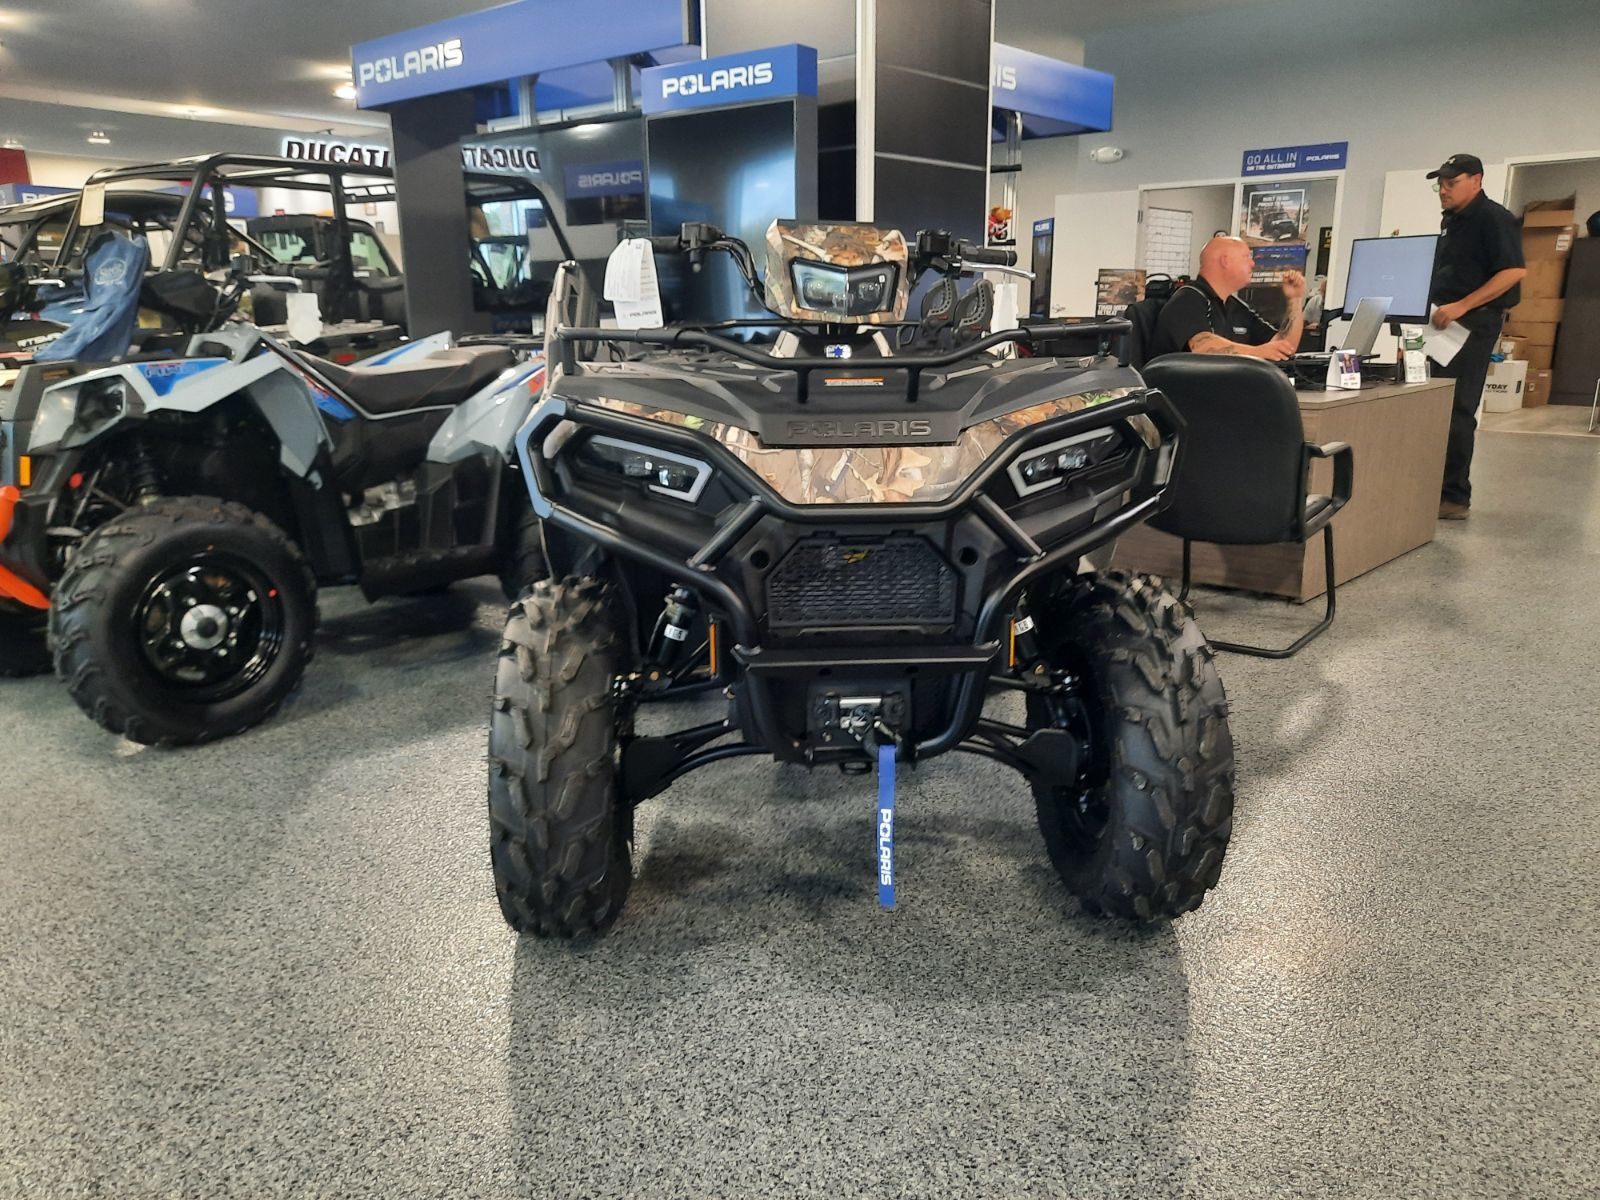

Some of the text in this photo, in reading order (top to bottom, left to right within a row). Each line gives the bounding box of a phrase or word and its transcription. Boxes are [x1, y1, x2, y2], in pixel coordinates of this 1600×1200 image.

[359, 39, 463, 88] POLARIS
[662, 62, 773, 98] POLARIS
[286, 140, 391, 169] DUCATI
[1246, 151, 1298, 165] GO ALL IN
[1266, 162, 1296, 170] OUTDOORS
[1305, 153, 1340, 162] POLARIS
[786, 420, 932, 439] POLARIS
[879, 808, 892, 886] POLARIS
